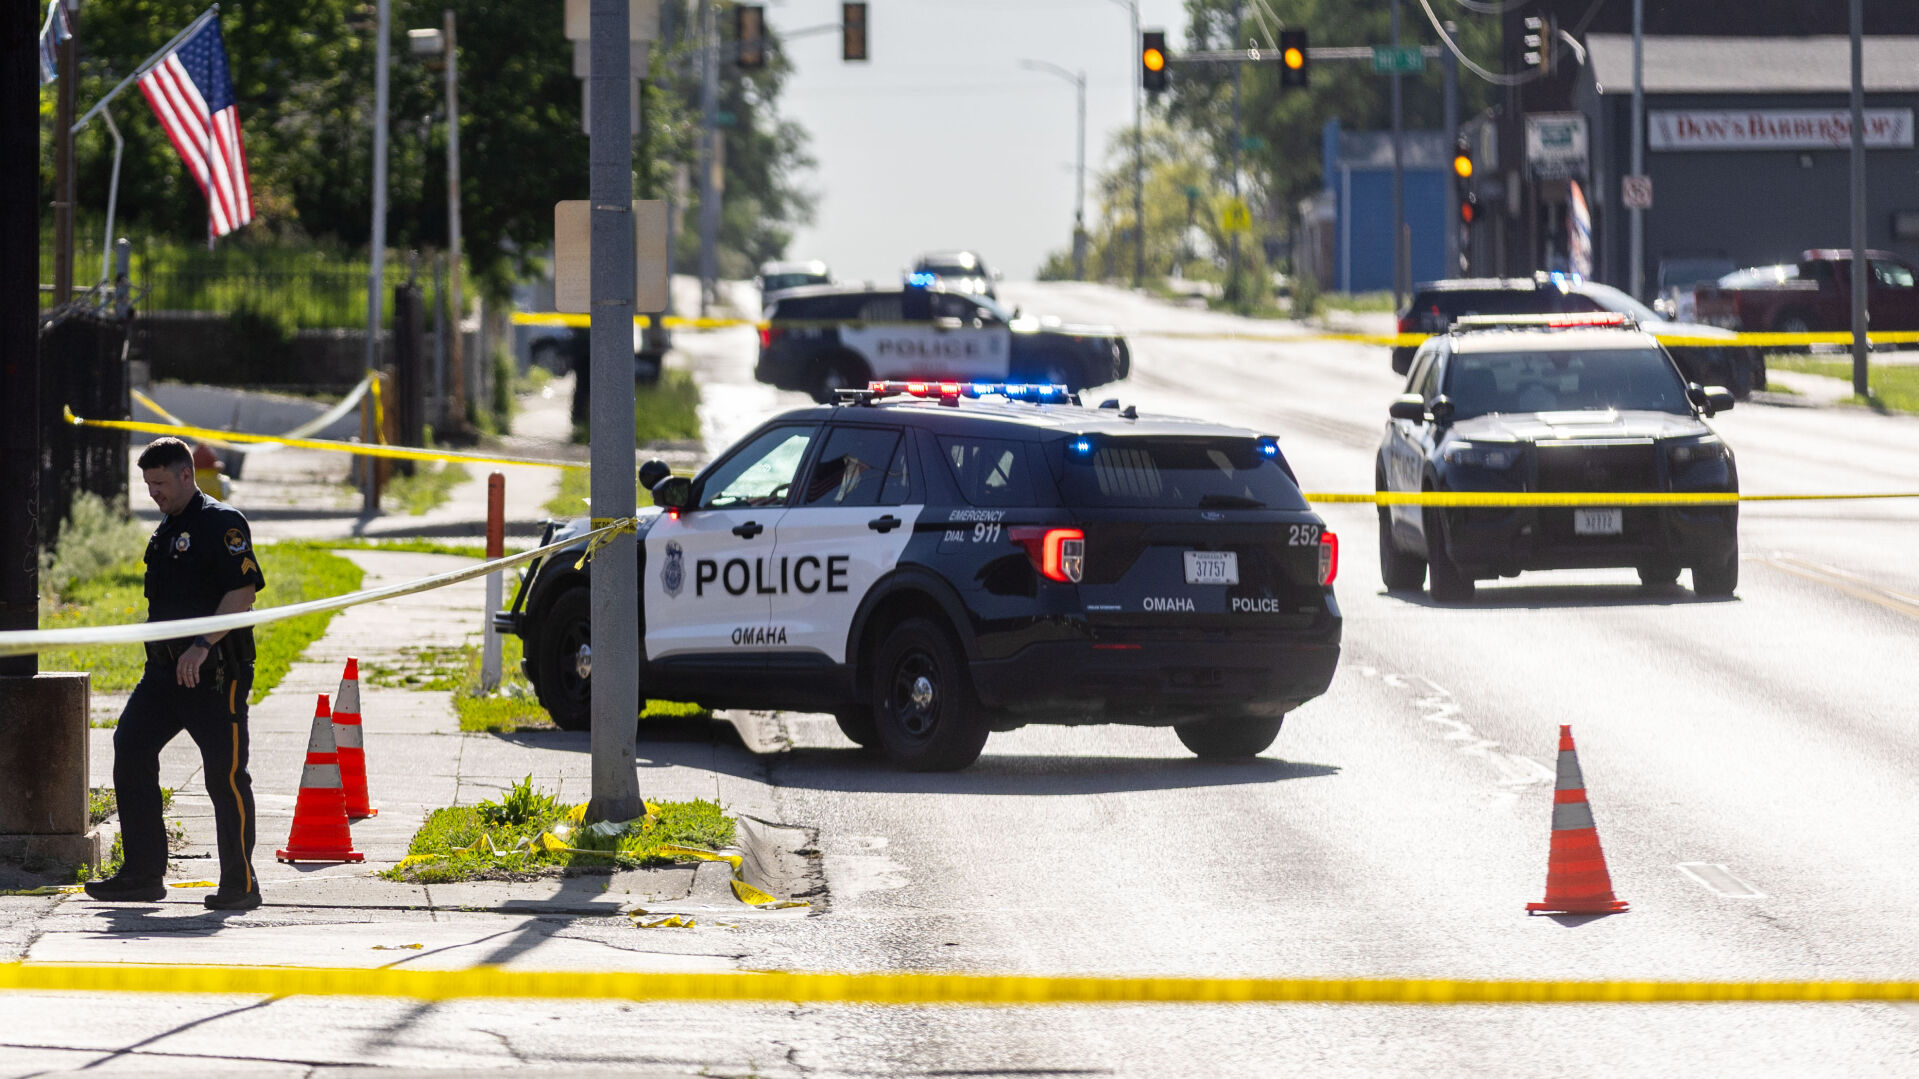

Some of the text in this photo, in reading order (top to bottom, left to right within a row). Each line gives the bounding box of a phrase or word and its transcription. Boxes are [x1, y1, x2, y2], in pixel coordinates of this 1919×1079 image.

[949, 509, 1006, 521] EMERGENCY
[944, 522, 1001, 543] DIAL 911
[1288, 525, 1319, 546] 252
[696, 555, 850, 597] POLICE
[1195, 561, 1226, 578] 37757
[1143, 597, 1280, 612] OMAHA POLICE
[731, 626, 788, 645] OMAHA
